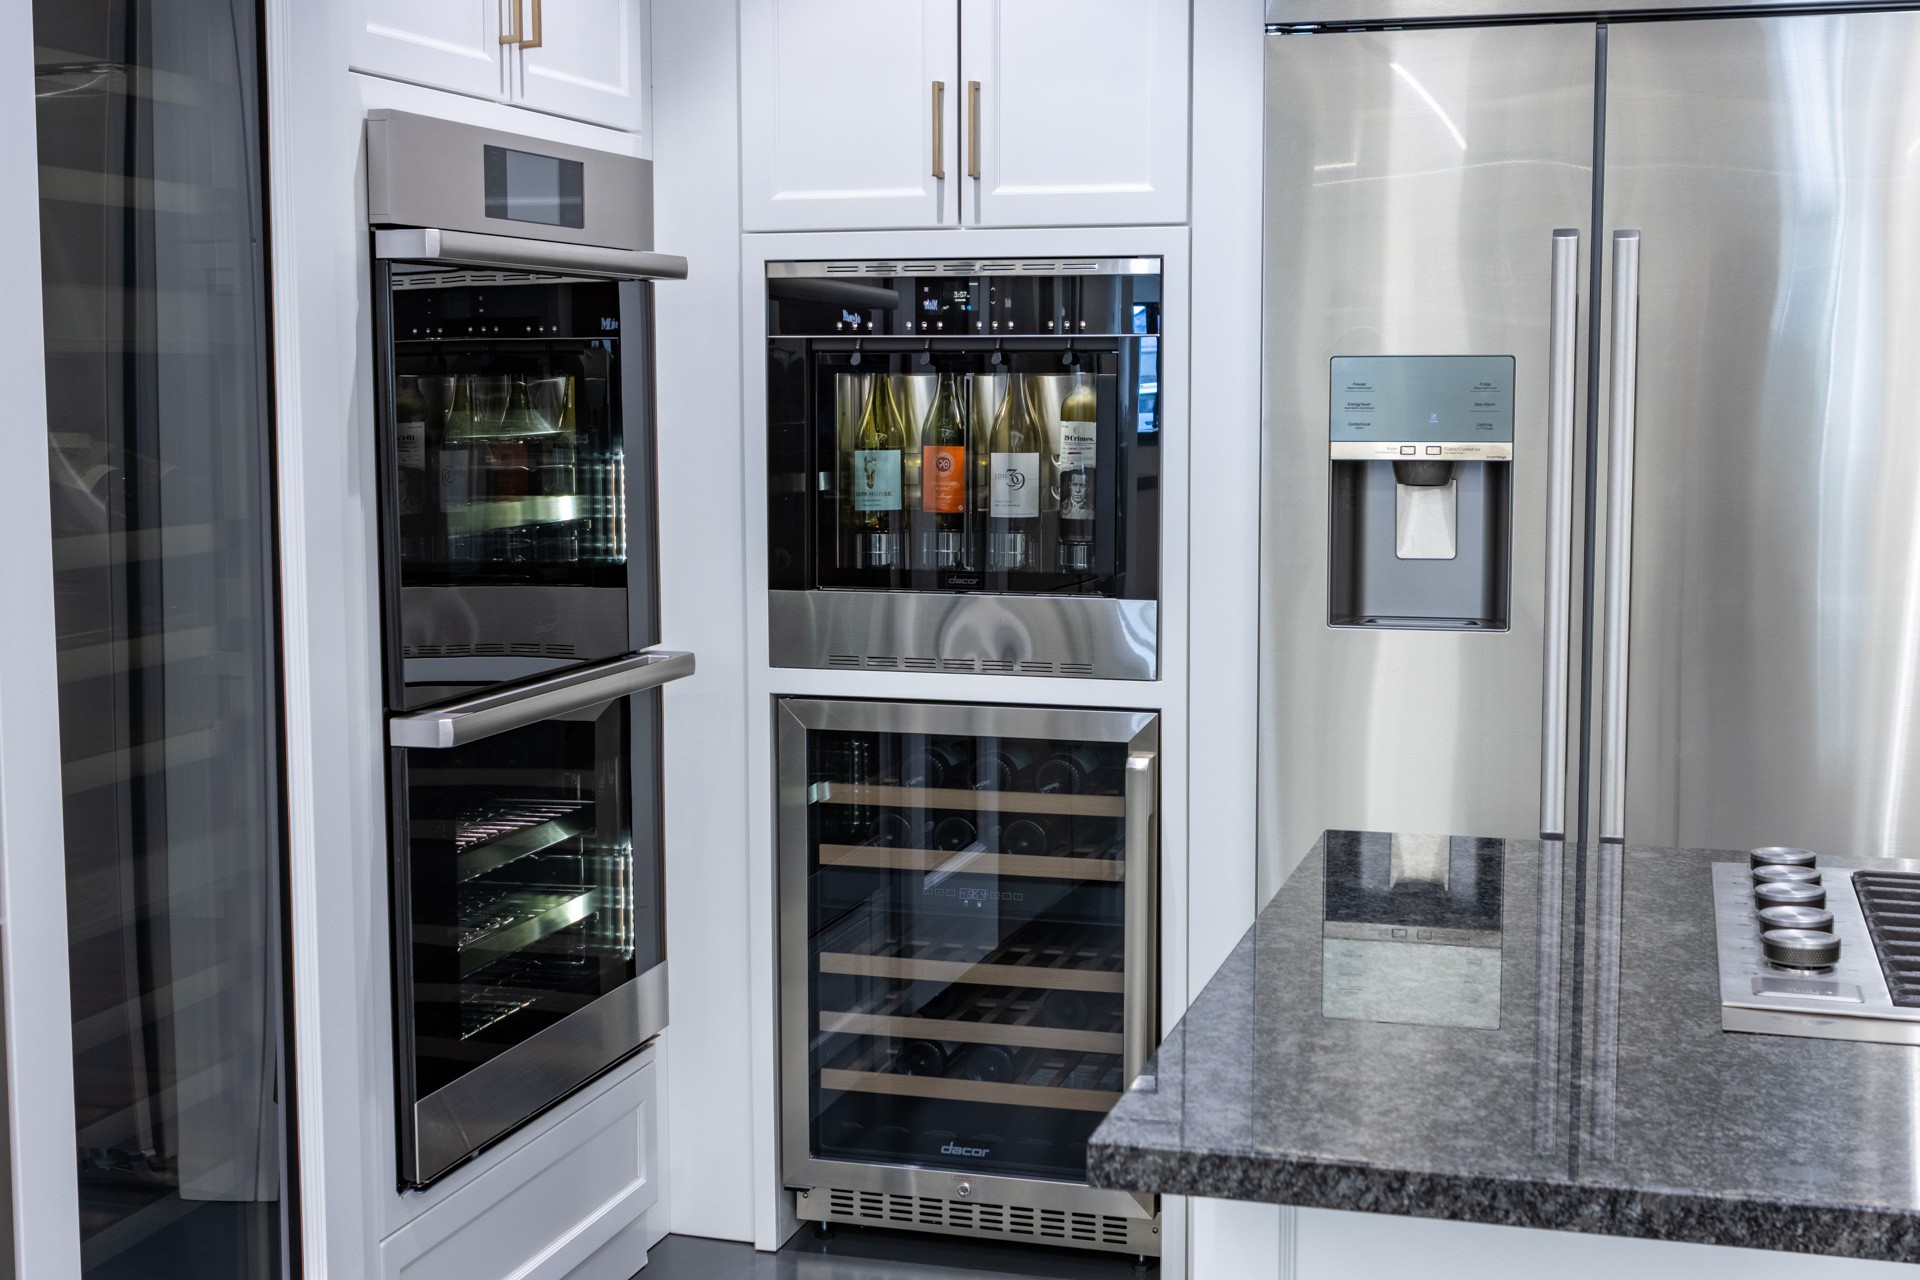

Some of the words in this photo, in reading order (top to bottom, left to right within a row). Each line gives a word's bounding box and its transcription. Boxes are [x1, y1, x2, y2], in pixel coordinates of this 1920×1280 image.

[937, 459, 950, 470] 90
[1005, 468, 1026, 491] 39
[948, 575, 979, 585] dacor
[940, 1141, 990, 1157] dacor
